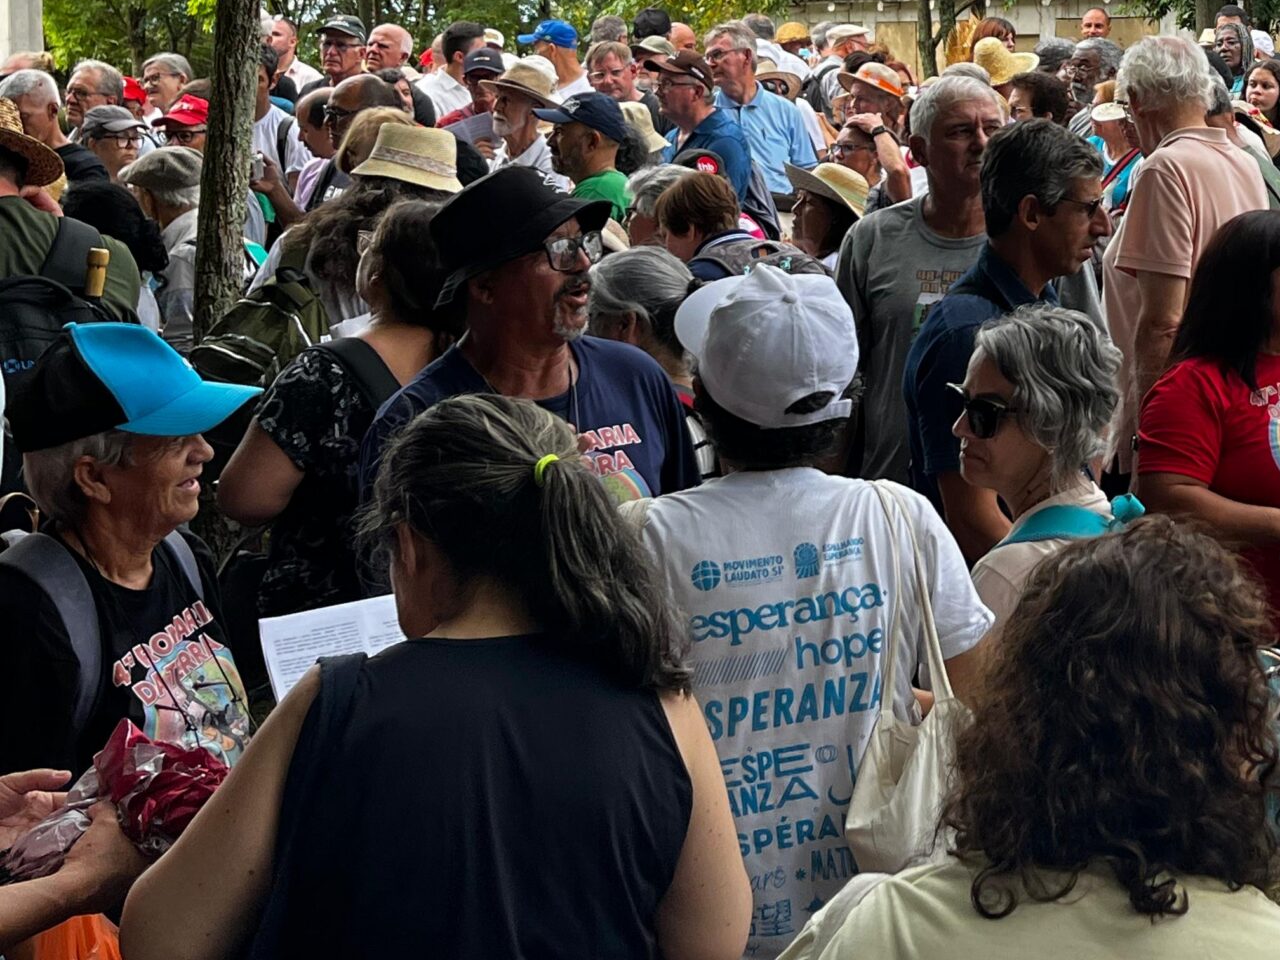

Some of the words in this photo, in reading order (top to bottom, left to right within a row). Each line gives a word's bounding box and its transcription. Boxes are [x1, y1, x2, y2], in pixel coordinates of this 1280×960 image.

[577, 423, 642, 454] ARIA
[723, 555, 784, 572] MOVIMENTO
[725, 568, 769, 584] LAUDATO
[690, 583, 885, 646] esperança
[795, 628, 882, 669] hope
[737, 813, 847, 858] SPÉRA
[750, 898, 795, 937] 望
